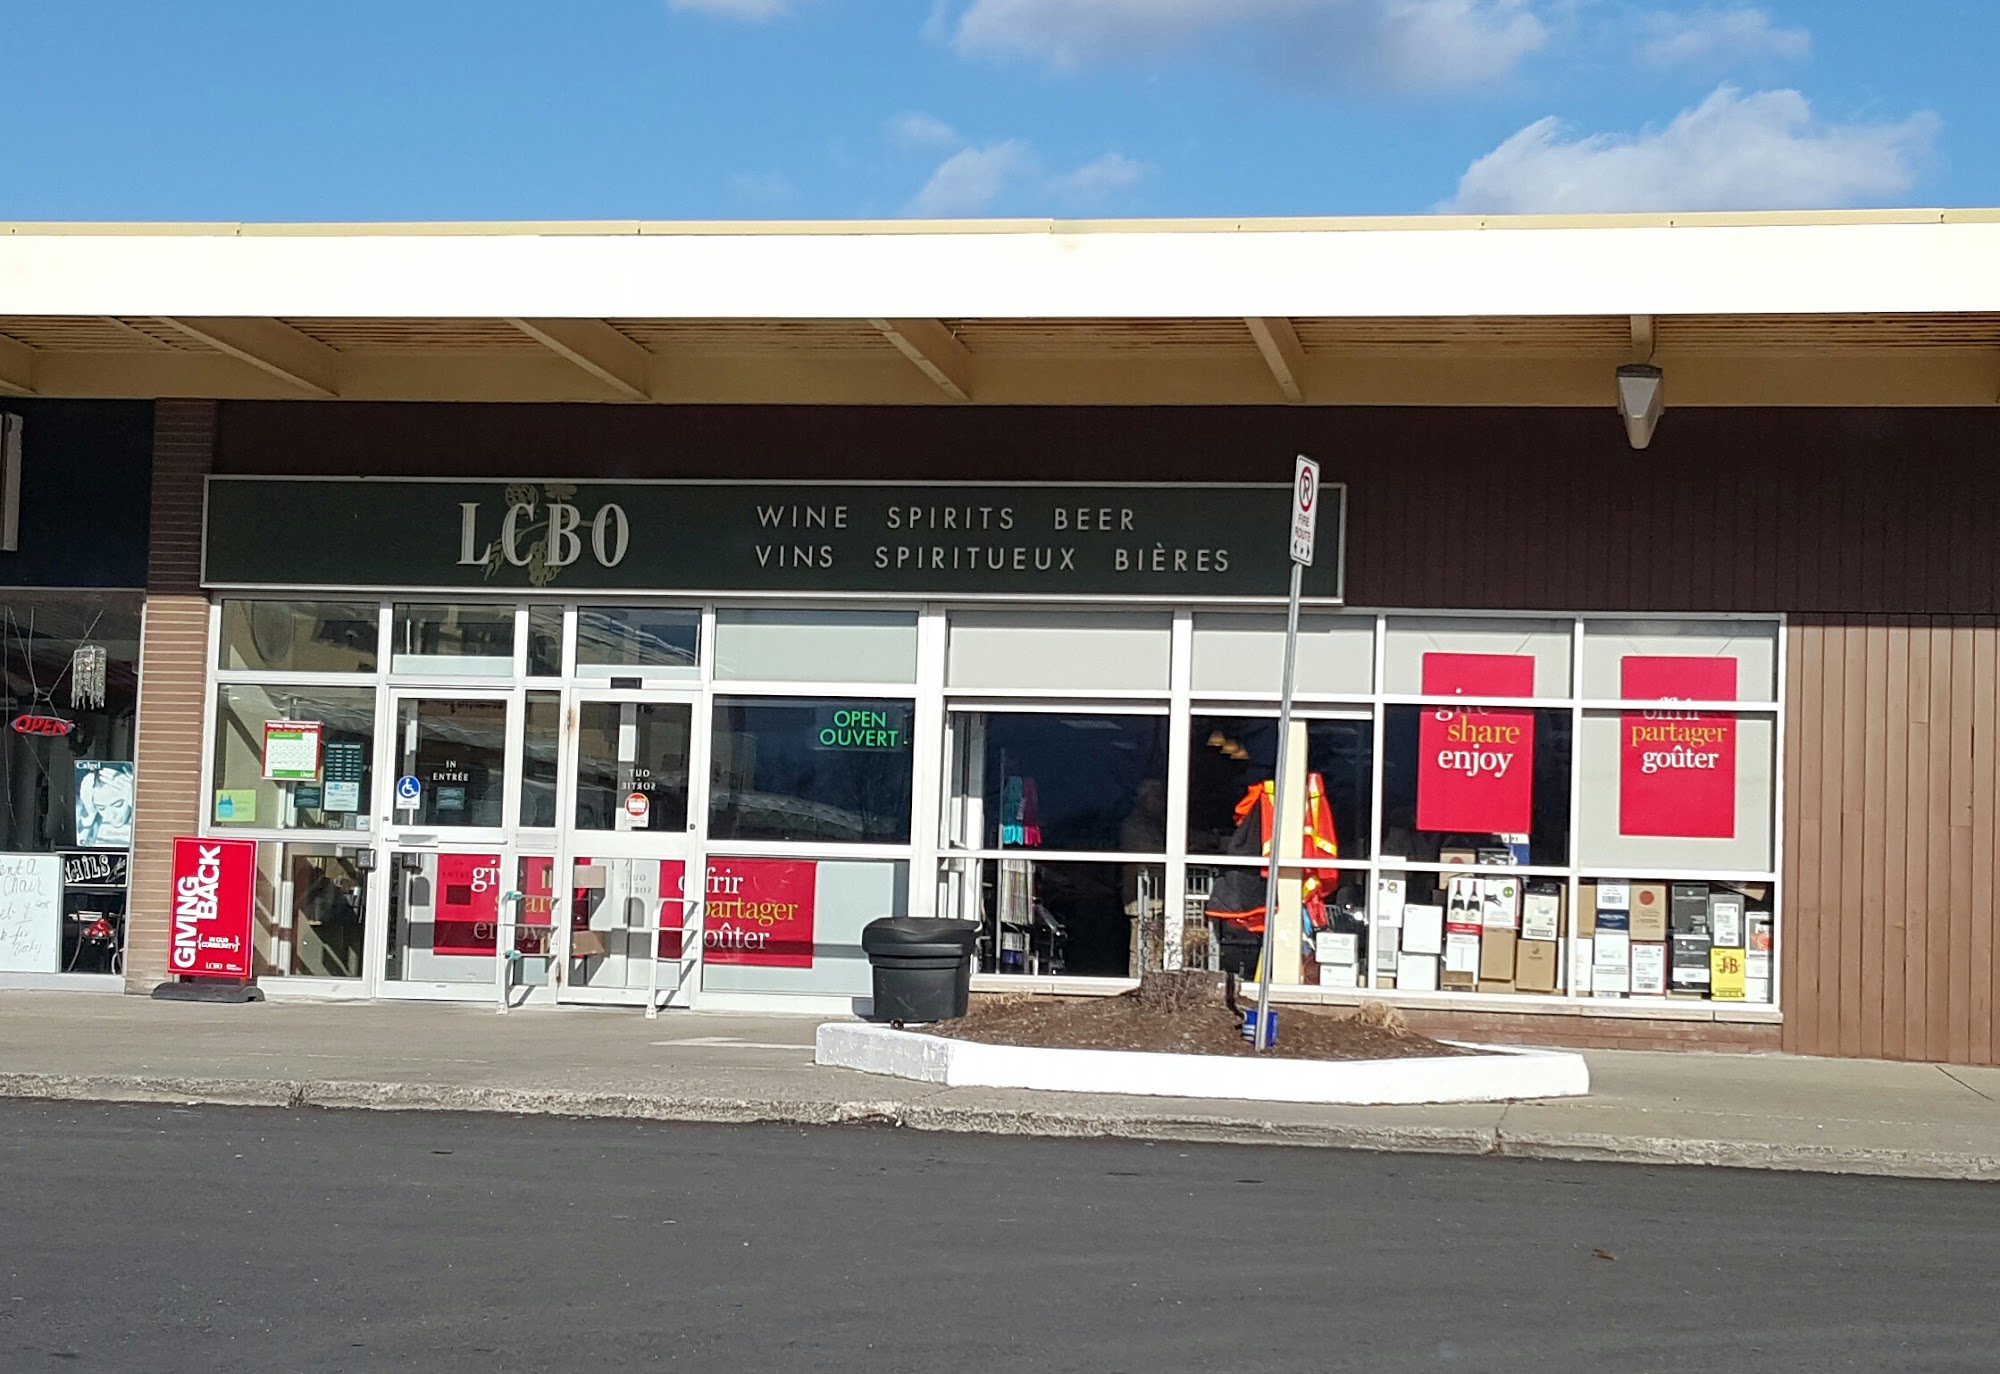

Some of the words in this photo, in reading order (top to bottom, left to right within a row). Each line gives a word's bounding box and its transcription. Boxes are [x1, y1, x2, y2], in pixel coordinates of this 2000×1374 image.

[757, 505, 849, 529] WINE
[886, 506, 1014, 530] SPIRITS
[1054, 508, 1135, 532] BEER
[457, 502, 630, 568] LCBO
[755, 545, 833, 569] VINS
[874, 546, 1076, 571] SPIRITUEUX
[1115, 543, 1230, 573] BIÈRES
[14, 715, 70, 736] OPEN
[834, 710, 886, 728] OPEN
[1447, 715, 1521, 744] share
[819, 728, 899, 747] OUVERT
[1631, 722, 1728, 747] partager
[445, 760, 457, 768] IN
[1437, 744, 1513, 778] enjoy
[1641, 745, 1720, 774] goûter
[432, 772, 469, 782] ENTRÉE
[197, 844, 221, 920] BACK
[173, 876, 199, 968] GIVING
[704, 921, 770, 950] oûter
